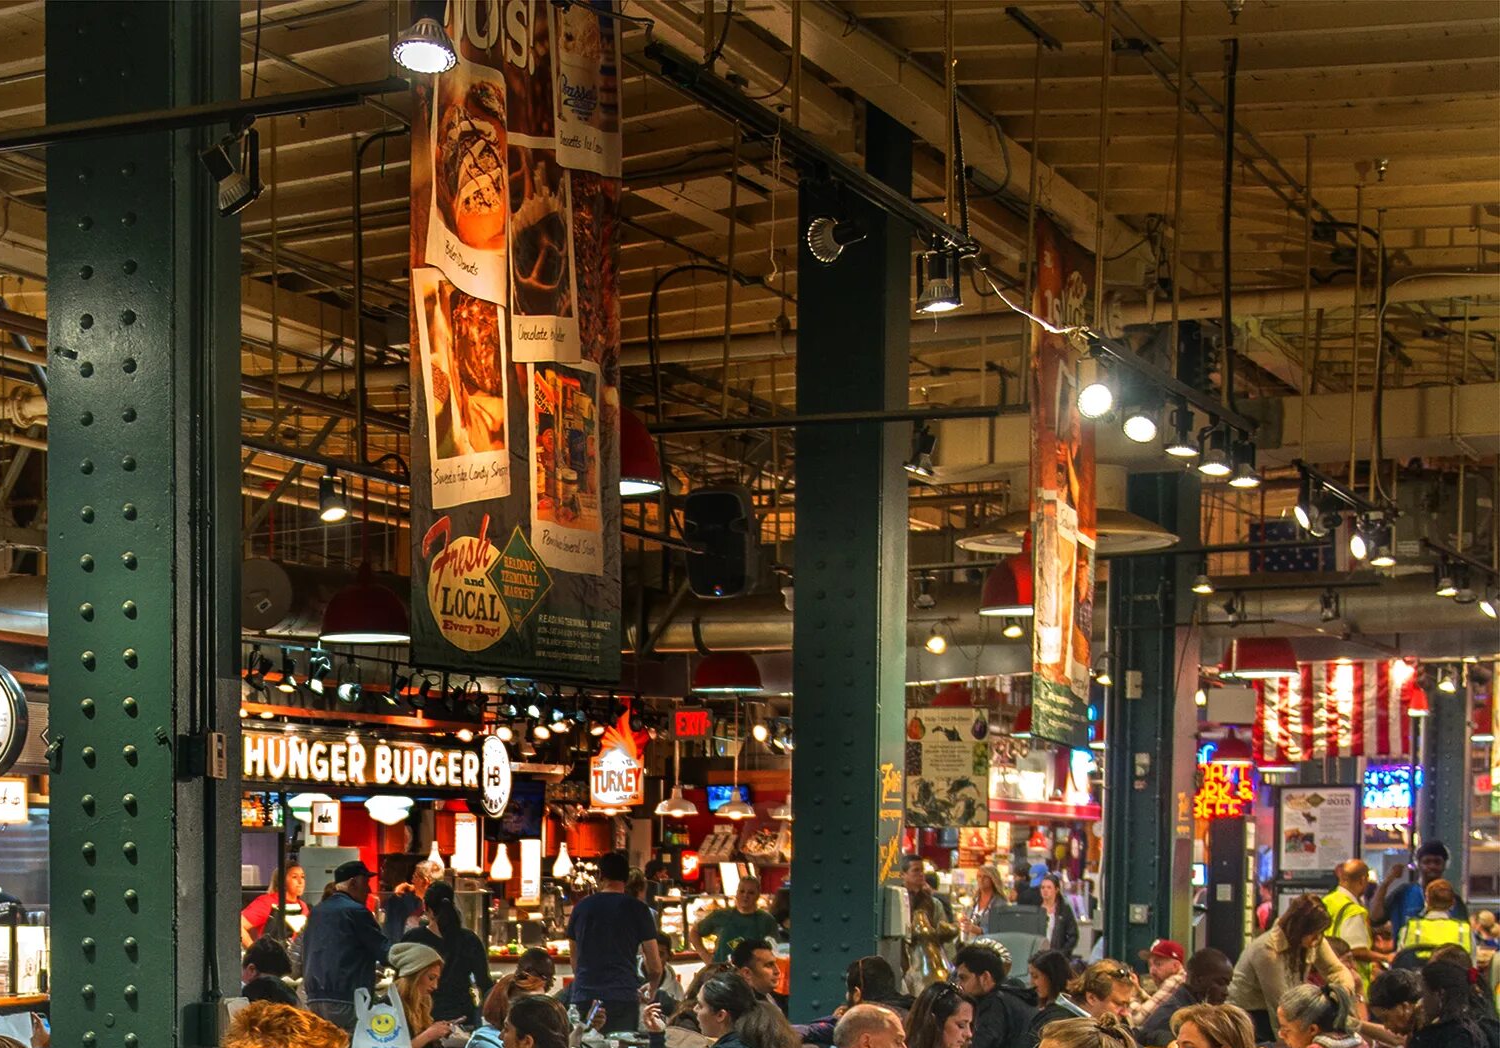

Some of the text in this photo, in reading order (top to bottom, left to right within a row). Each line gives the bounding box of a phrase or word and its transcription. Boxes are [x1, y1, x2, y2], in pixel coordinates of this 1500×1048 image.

[422, 513, 492, 602] Fresh
[464, 577, 485, 588] and
[501, 570, 539, 587] TERMINAL
[440, 587, 500, 623] LOCAL
[442, 620, 500, 637] Every Day!
[243, 736, 480, 788] HUNGER BURGER
[592, 768, 642, 793] TURKEY
